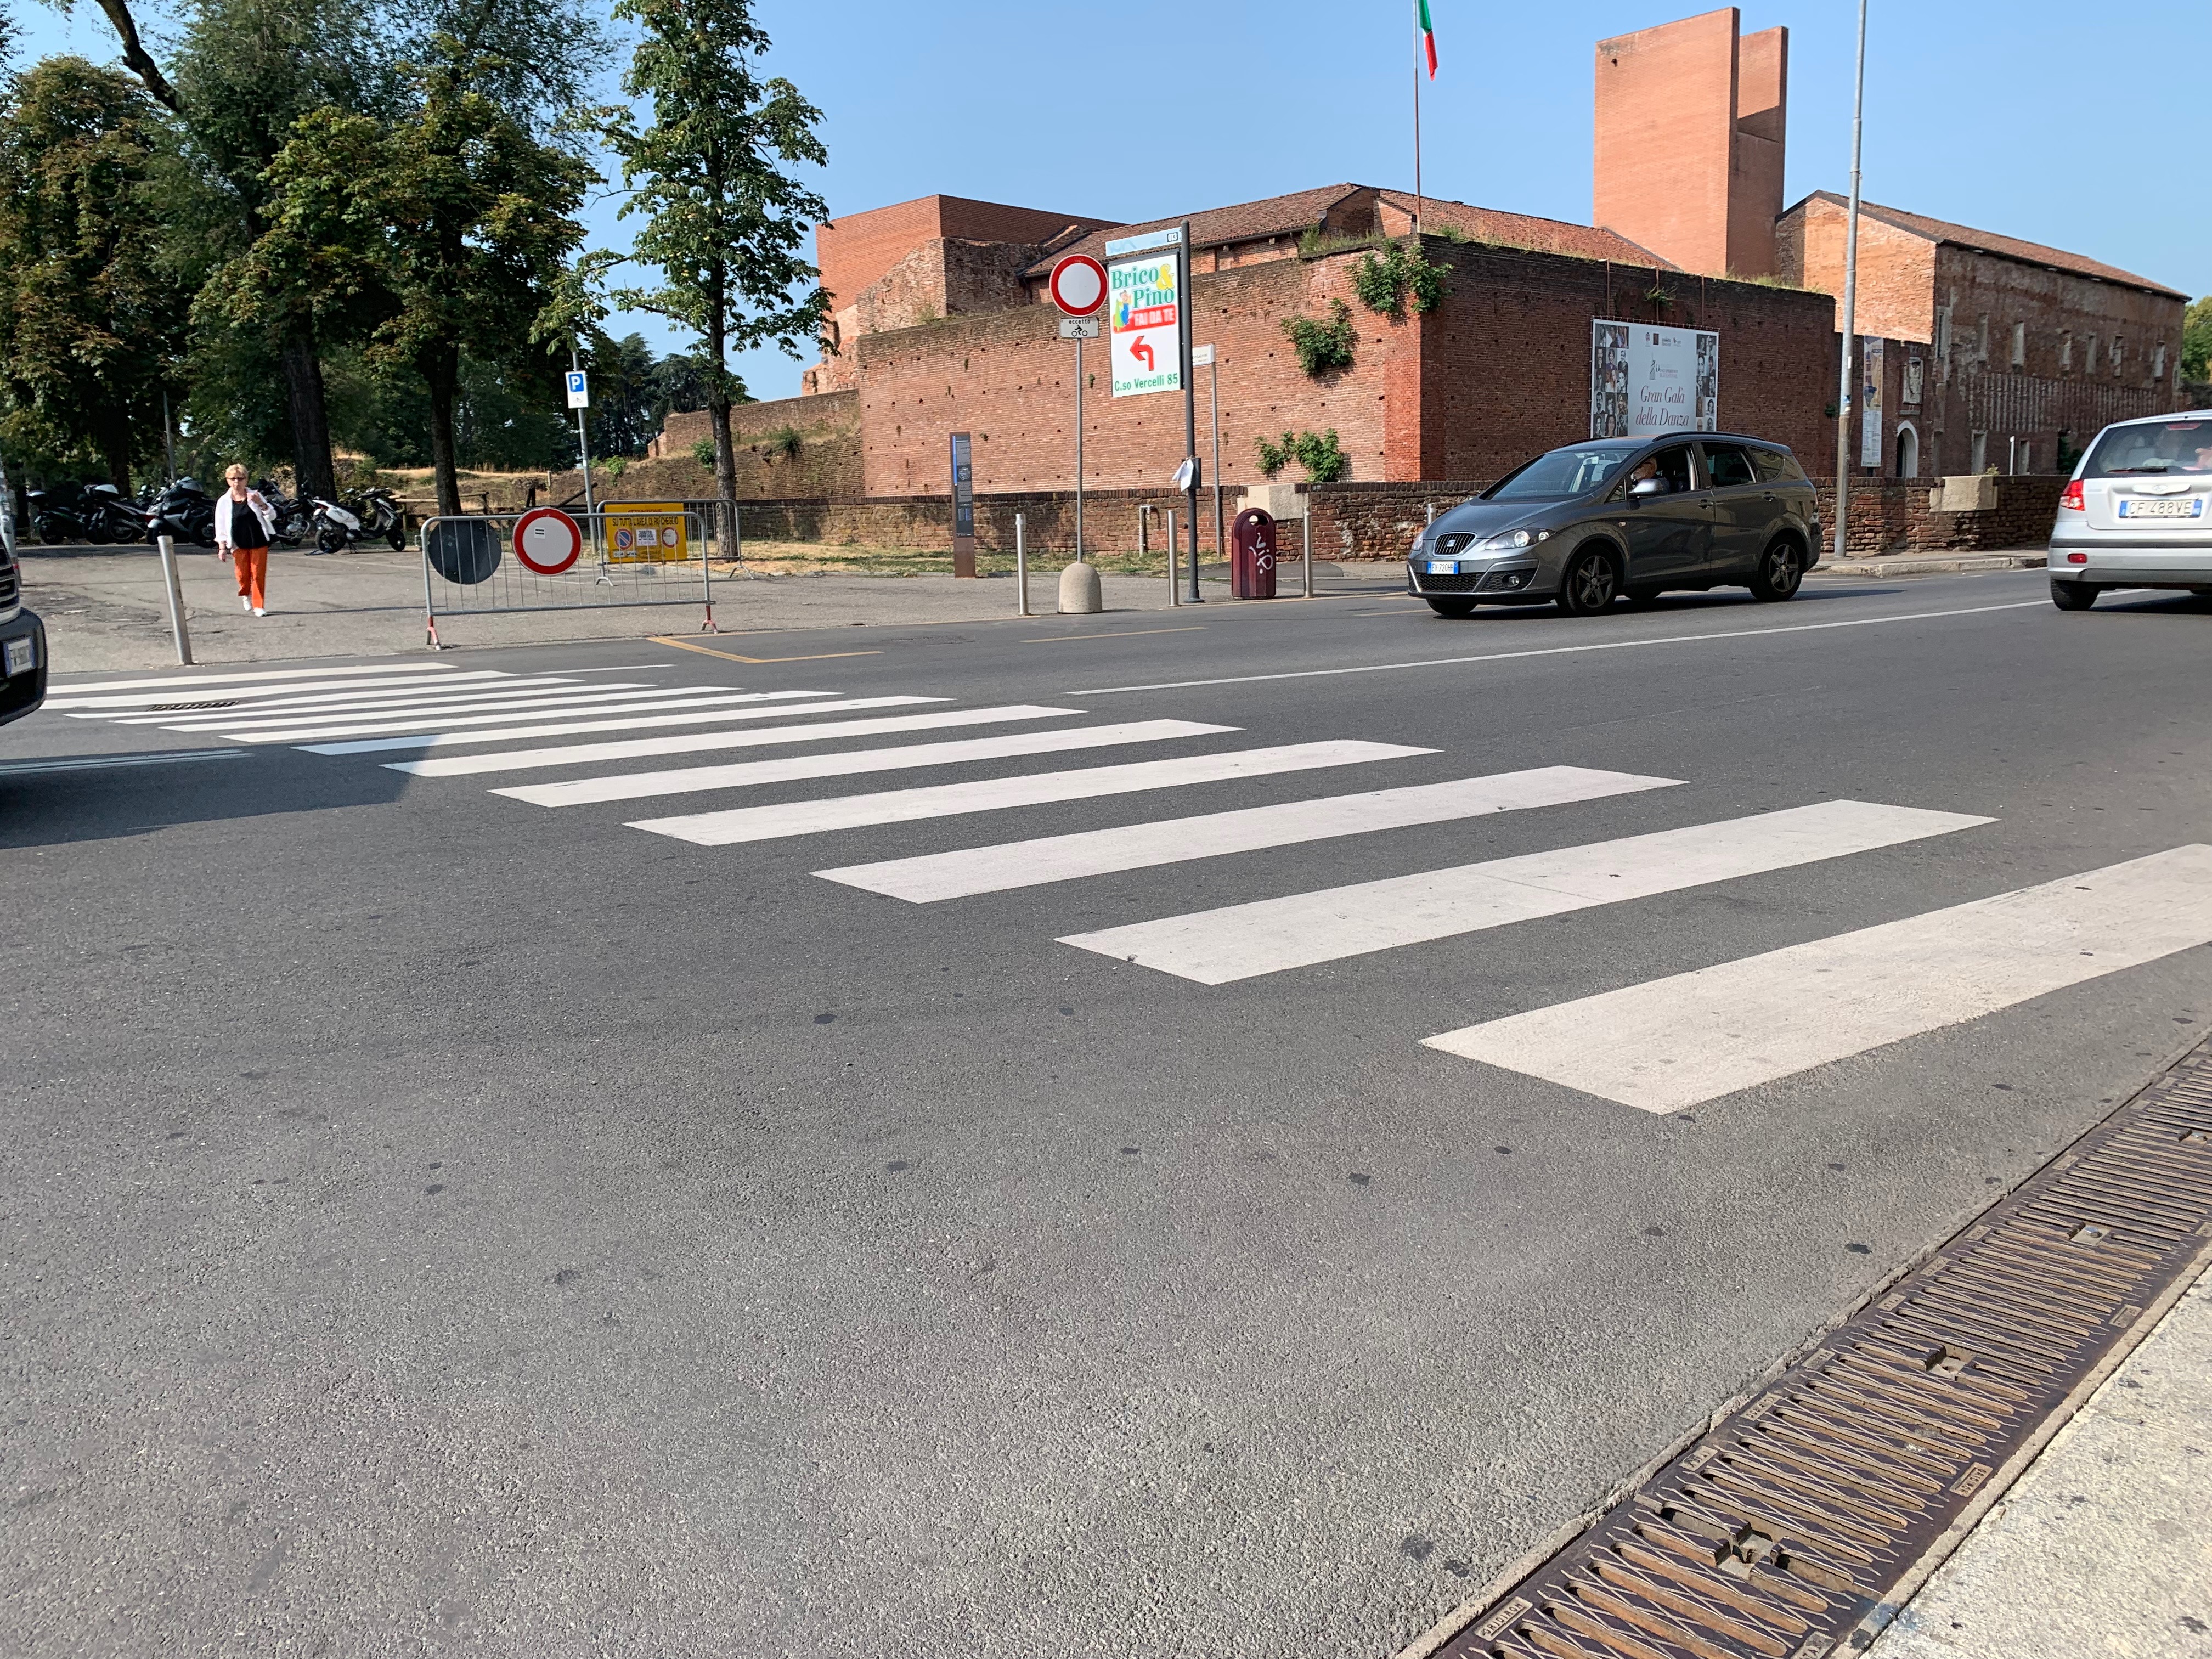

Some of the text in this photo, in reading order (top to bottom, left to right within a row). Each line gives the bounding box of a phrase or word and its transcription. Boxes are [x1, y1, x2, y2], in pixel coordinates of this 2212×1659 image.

[1111, 267, 1159, 290] Brico
[1133, 287, 1175, 308] Pino
[1134, 312, 1148, 326] FAI
[1163, 307, 1174, 322] TE
[571, 376, 581, 391] P
[1114, 373, 1178, 391] C.so Vercelli 85
[1641, 385, 1685, 404] Gran Galà
[1635, 406, 1689, 426] della Danza
[2129, 501, 2192, 514] CF 488VE
[1482, 1602, 1523, 1634] GRIDIRON
